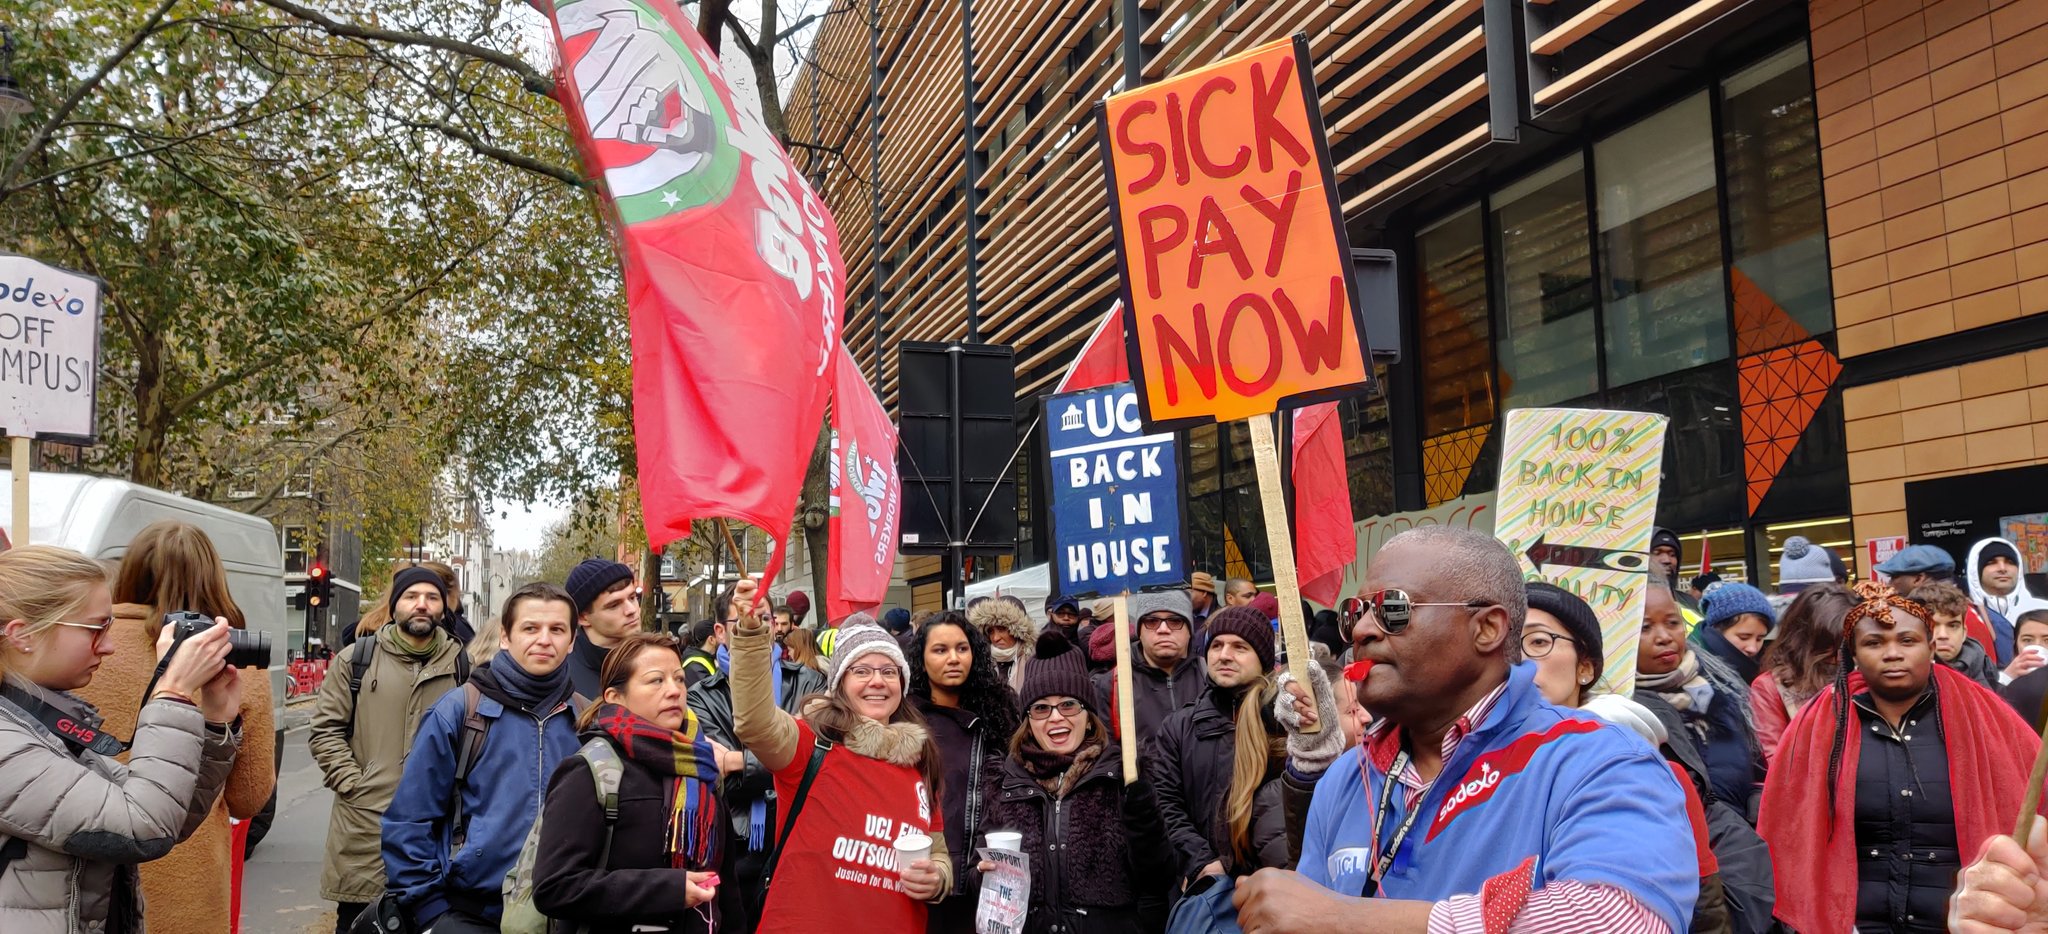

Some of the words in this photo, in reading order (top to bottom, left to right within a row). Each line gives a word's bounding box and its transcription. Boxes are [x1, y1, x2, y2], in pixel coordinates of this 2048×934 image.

[1116, 55, 1311, 194] SICK
[1138, 170, 1303, 300] PAY
[0, 313, 55, 348] OFF
[1151, 275, 1345, 407] NOW
[1085, 392, 1143, 438] UC
[1547, 422, 1635, 454] 100%
[1069, 446, 1162, 488] BACK
[1517, 460, 1595, 489] BACK
[1601, 466, 1643, 492] IN
[1088, 492, 1153, 530] IN
[1527, 498, 1626, 530] HOUSE
[1067, 536, 1171, 583] HOUSE
[1438, 761, 1501, 823] sodexo
[864, 813, 894, 841] UCL
[835, 866, 868, 885] Justice
[868, 874, 882, 888] for
[988, 851, 1022, 869] SUPPORT
[999, 884, 1013, 901] THE
[987, 918, 1012, 934] STRIKE
